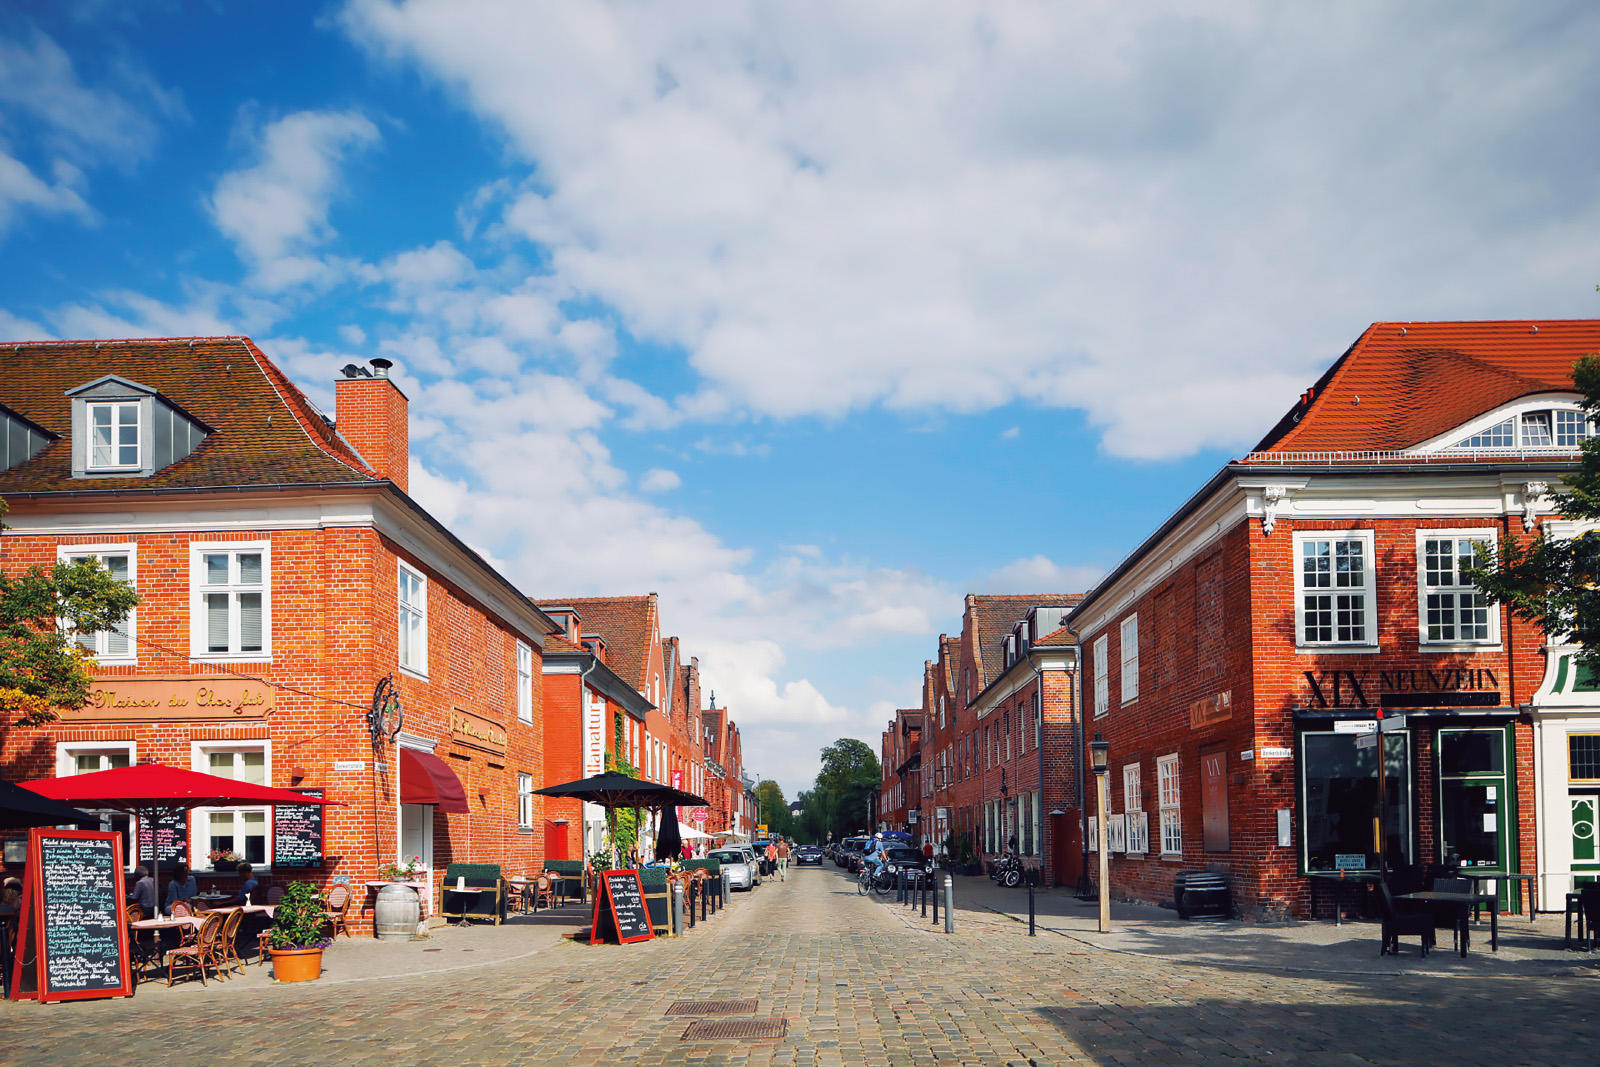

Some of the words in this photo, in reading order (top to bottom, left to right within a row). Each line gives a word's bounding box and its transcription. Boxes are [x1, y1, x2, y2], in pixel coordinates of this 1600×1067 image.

[95, 689, 160, 708] Maison
[168, 694, 188, 707] du
[1303, 670, 1368, 708] XIX
[1380, 669, 1499, 690] NEUNZEHN
[586, 705, 601, 778] llanatur
